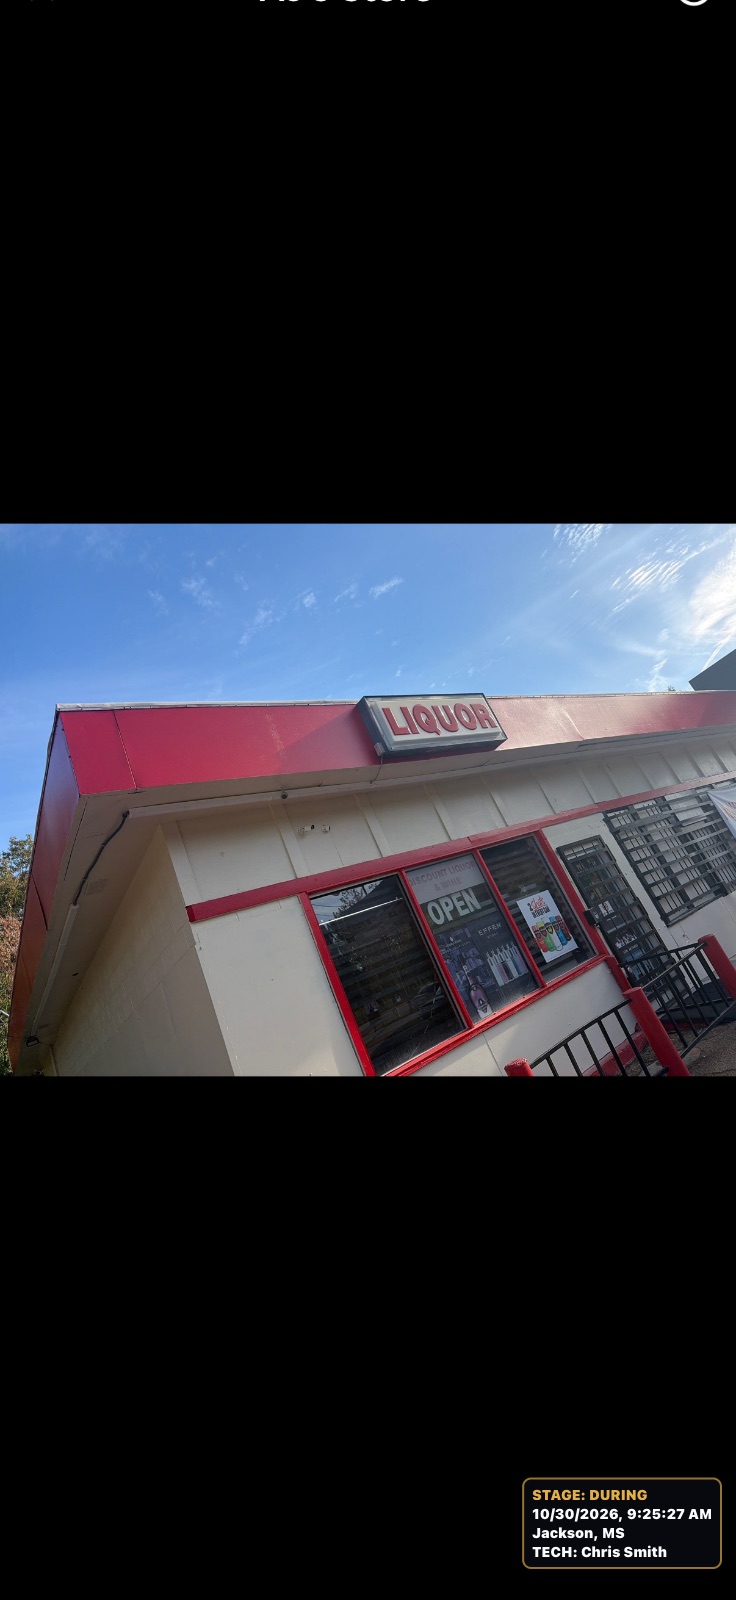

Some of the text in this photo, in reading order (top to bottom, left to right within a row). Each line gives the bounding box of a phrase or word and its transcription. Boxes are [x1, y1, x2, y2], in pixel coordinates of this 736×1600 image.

[382, 703, 498, 736] LIQUOR
[447, 860, 477, 874] LIQUOR
[434, 877, 463, 891] & WINE
[427, 888, 482, 925] OPEN
[477, 922, 502, 936] EFFEN
